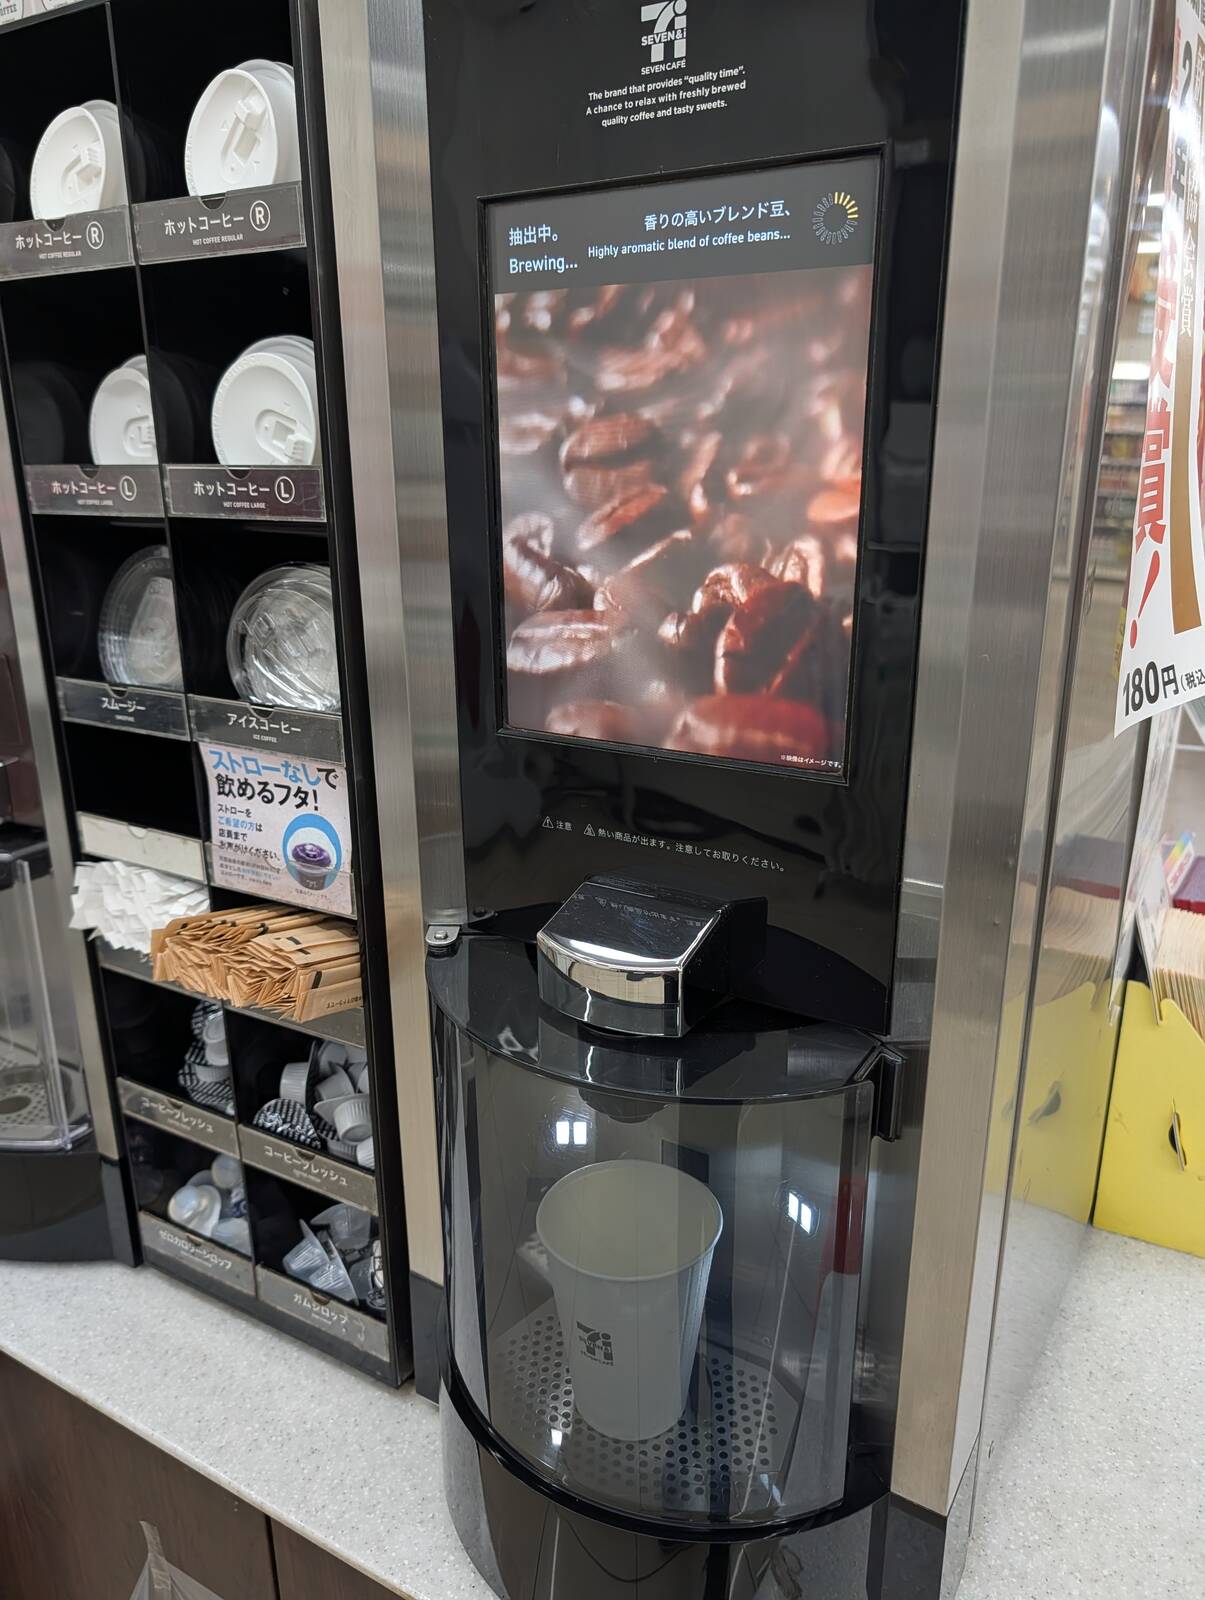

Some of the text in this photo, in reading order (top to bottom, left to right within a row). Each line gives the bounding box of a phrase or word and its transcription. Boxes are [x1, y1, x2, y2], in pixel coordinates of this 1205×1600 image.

[586, 80, 746, 115] A chance to relax with freshly brewed
[588, 92, 603, 101] The
[604, 86, 627, 98] brand
[629, 83, 645, 94] that
[647, 78, 683, 92] provides
[601, 99, 727, 127] quality coffee and tasty sweets.
[164, 213, 244, 236] ホットコーヒー
[644, 200, 791, 232] 香りの高いブレンド豆、
[15, 231, 82, 250] ホットコーヒー
[508, 223, 559, 246] 抽出中。
[588, 230, 791, 259] Highly aromatic blend of coffee beans...
[509, 255, 578, 275] Brewing...
[51, 480, 117, 495] ホットコーヒー
[193, 480, 270, 497] ホットコーヒー
[101, 696, 146, 713] スムージー
[227, 712, 302, 735] アイスコーヒー
[208, 749, 339, 791] ストローなしで
[217, 803, 252, 818] ストローを
[218, 828, 248, 842] 店員まで
[555, 819, 572, 832] 注意
